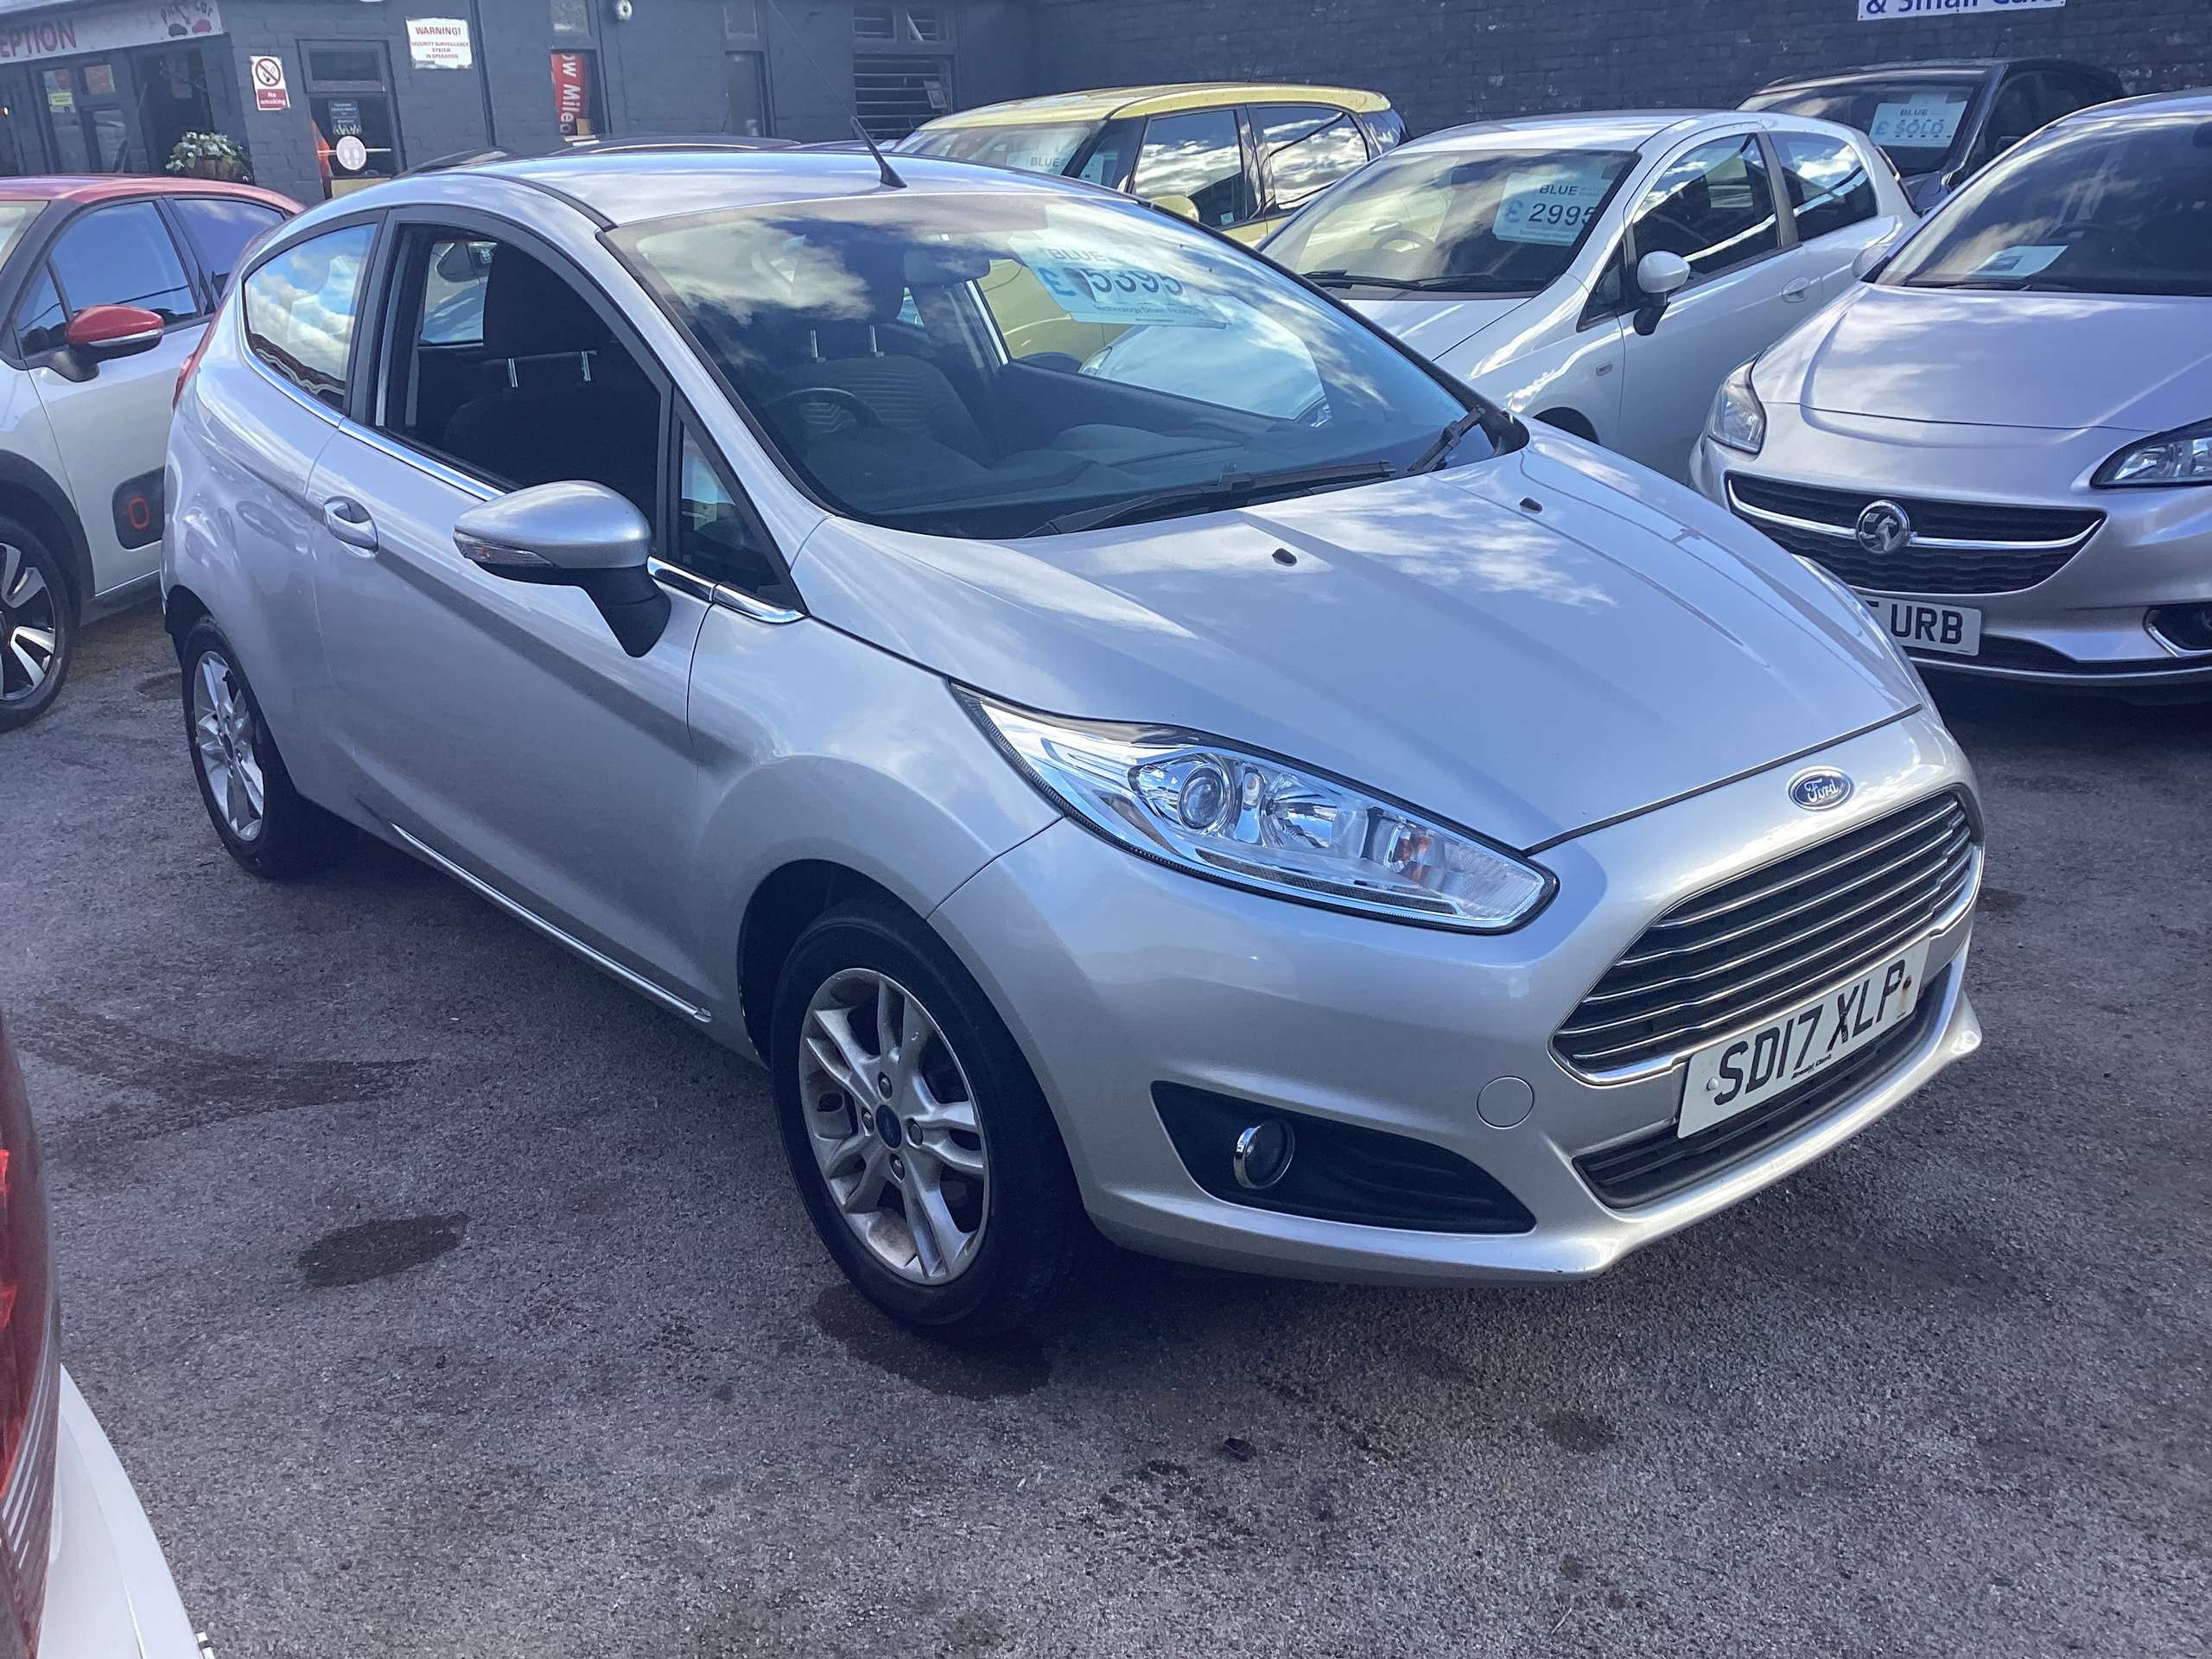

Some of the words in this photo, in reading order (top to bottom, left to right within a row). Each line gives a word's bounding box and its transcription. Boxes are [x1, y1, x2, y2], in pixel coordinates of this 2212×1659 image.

[415, 26, 461, 35] WARNING!
[1030, 157, 1061, 167] BLUE
[1539, 184, 1579, 196] BLUE
[1505, 200, 1523, 223] £
[1528, 203, 1598, 226] 2995
[1050, 249, 1107, 262] BLUE
[1891, 603, 1964, 645] URB
[1804, 778, 1839, 803] Ford
[1713, 1003, 1824, 1106] SD17
[1826, 959, 1906, 1052] XLP
